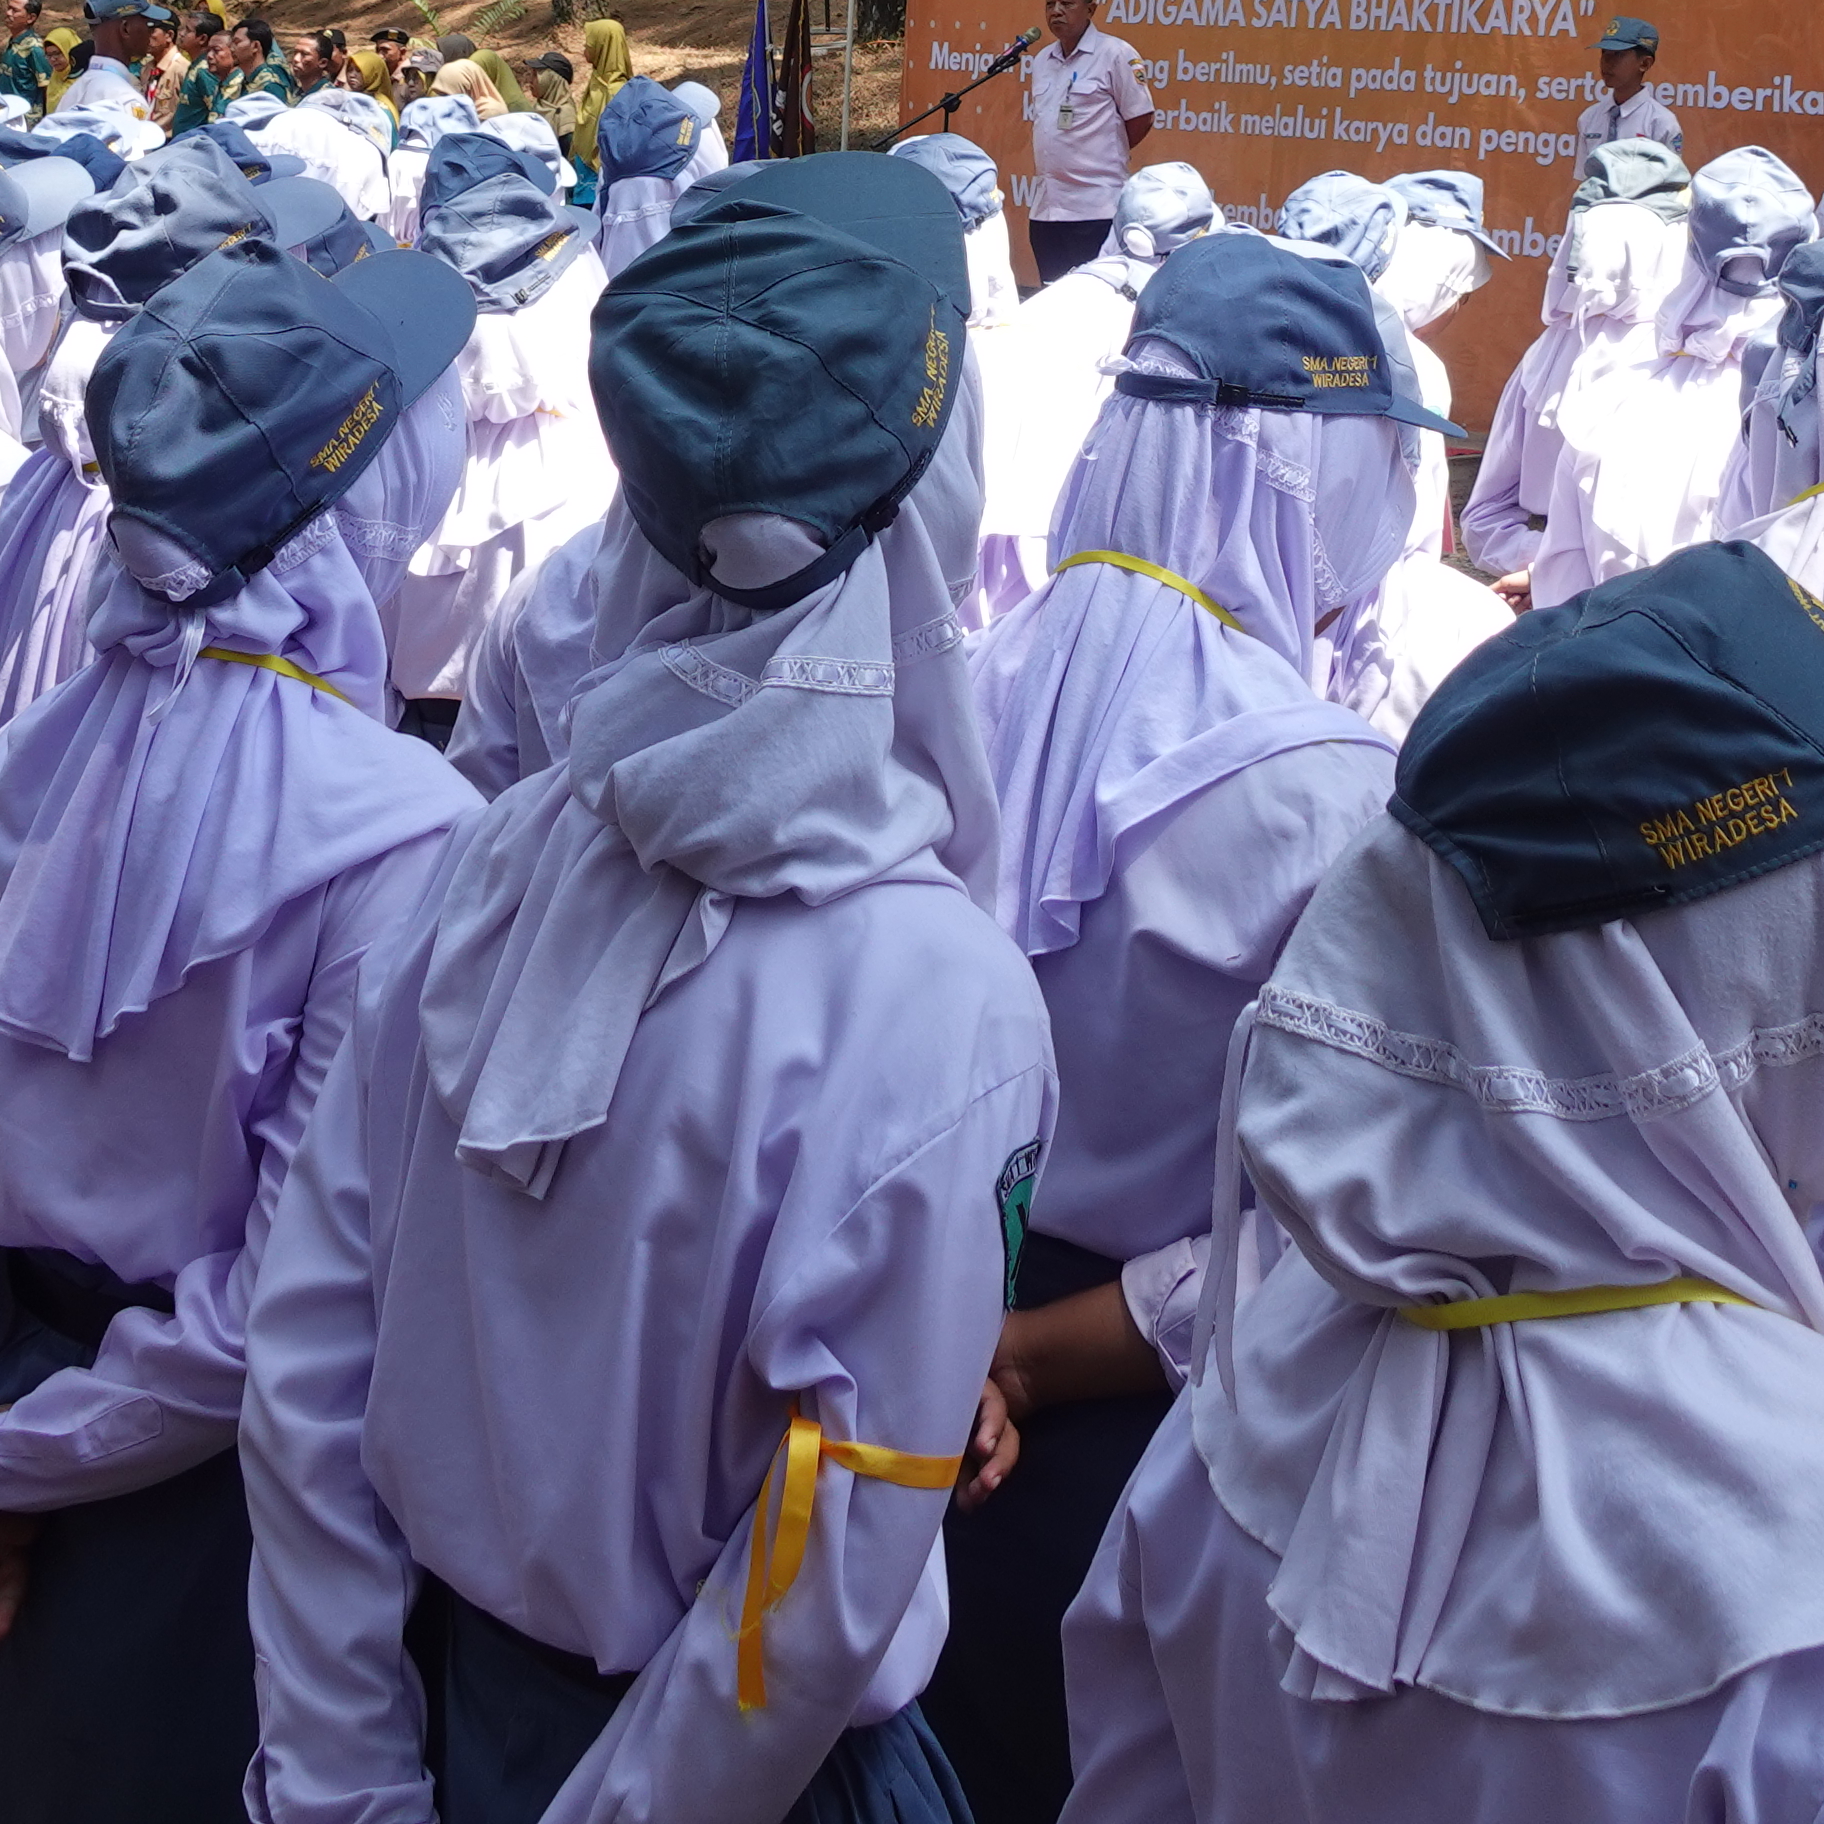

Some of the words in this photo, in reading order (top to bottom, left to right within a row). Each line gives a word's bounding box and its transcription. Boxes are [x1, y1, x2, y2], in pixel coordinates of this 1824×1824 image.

[1176, 48, 1277, 91] berilmu,
[1283, 55, 1342, 89] setia
[1350, 57, 1415, 98] pada
[1423, 60, 1527, 104] tujuan,
[1152, 98, 1236, 134] erbaik
[1240, 102, 1329, 140] melalui
[1333, 104, 1408, 152] karya
[1416, 111, 1472, 150] dan
[926, 328, 949, 429] WIRADESA
[1301, 355, 1328, 372] SMA
[1332, 355, 1368, 372] NEGERI
[1311, 372, 1370, 388] WIRADESA
[309, 437, 338, 468] SMA
[338, 386, 375, 438] NEGERI
[323, 400, 385, 473] WIRADESA
[911, 386, 935, 428] SMA
[1639, 809, 1695, 846] SMA
[1695, 774, 1780, 826] NEGERI
[1657, 796, 1799, 870] WIRADESA
